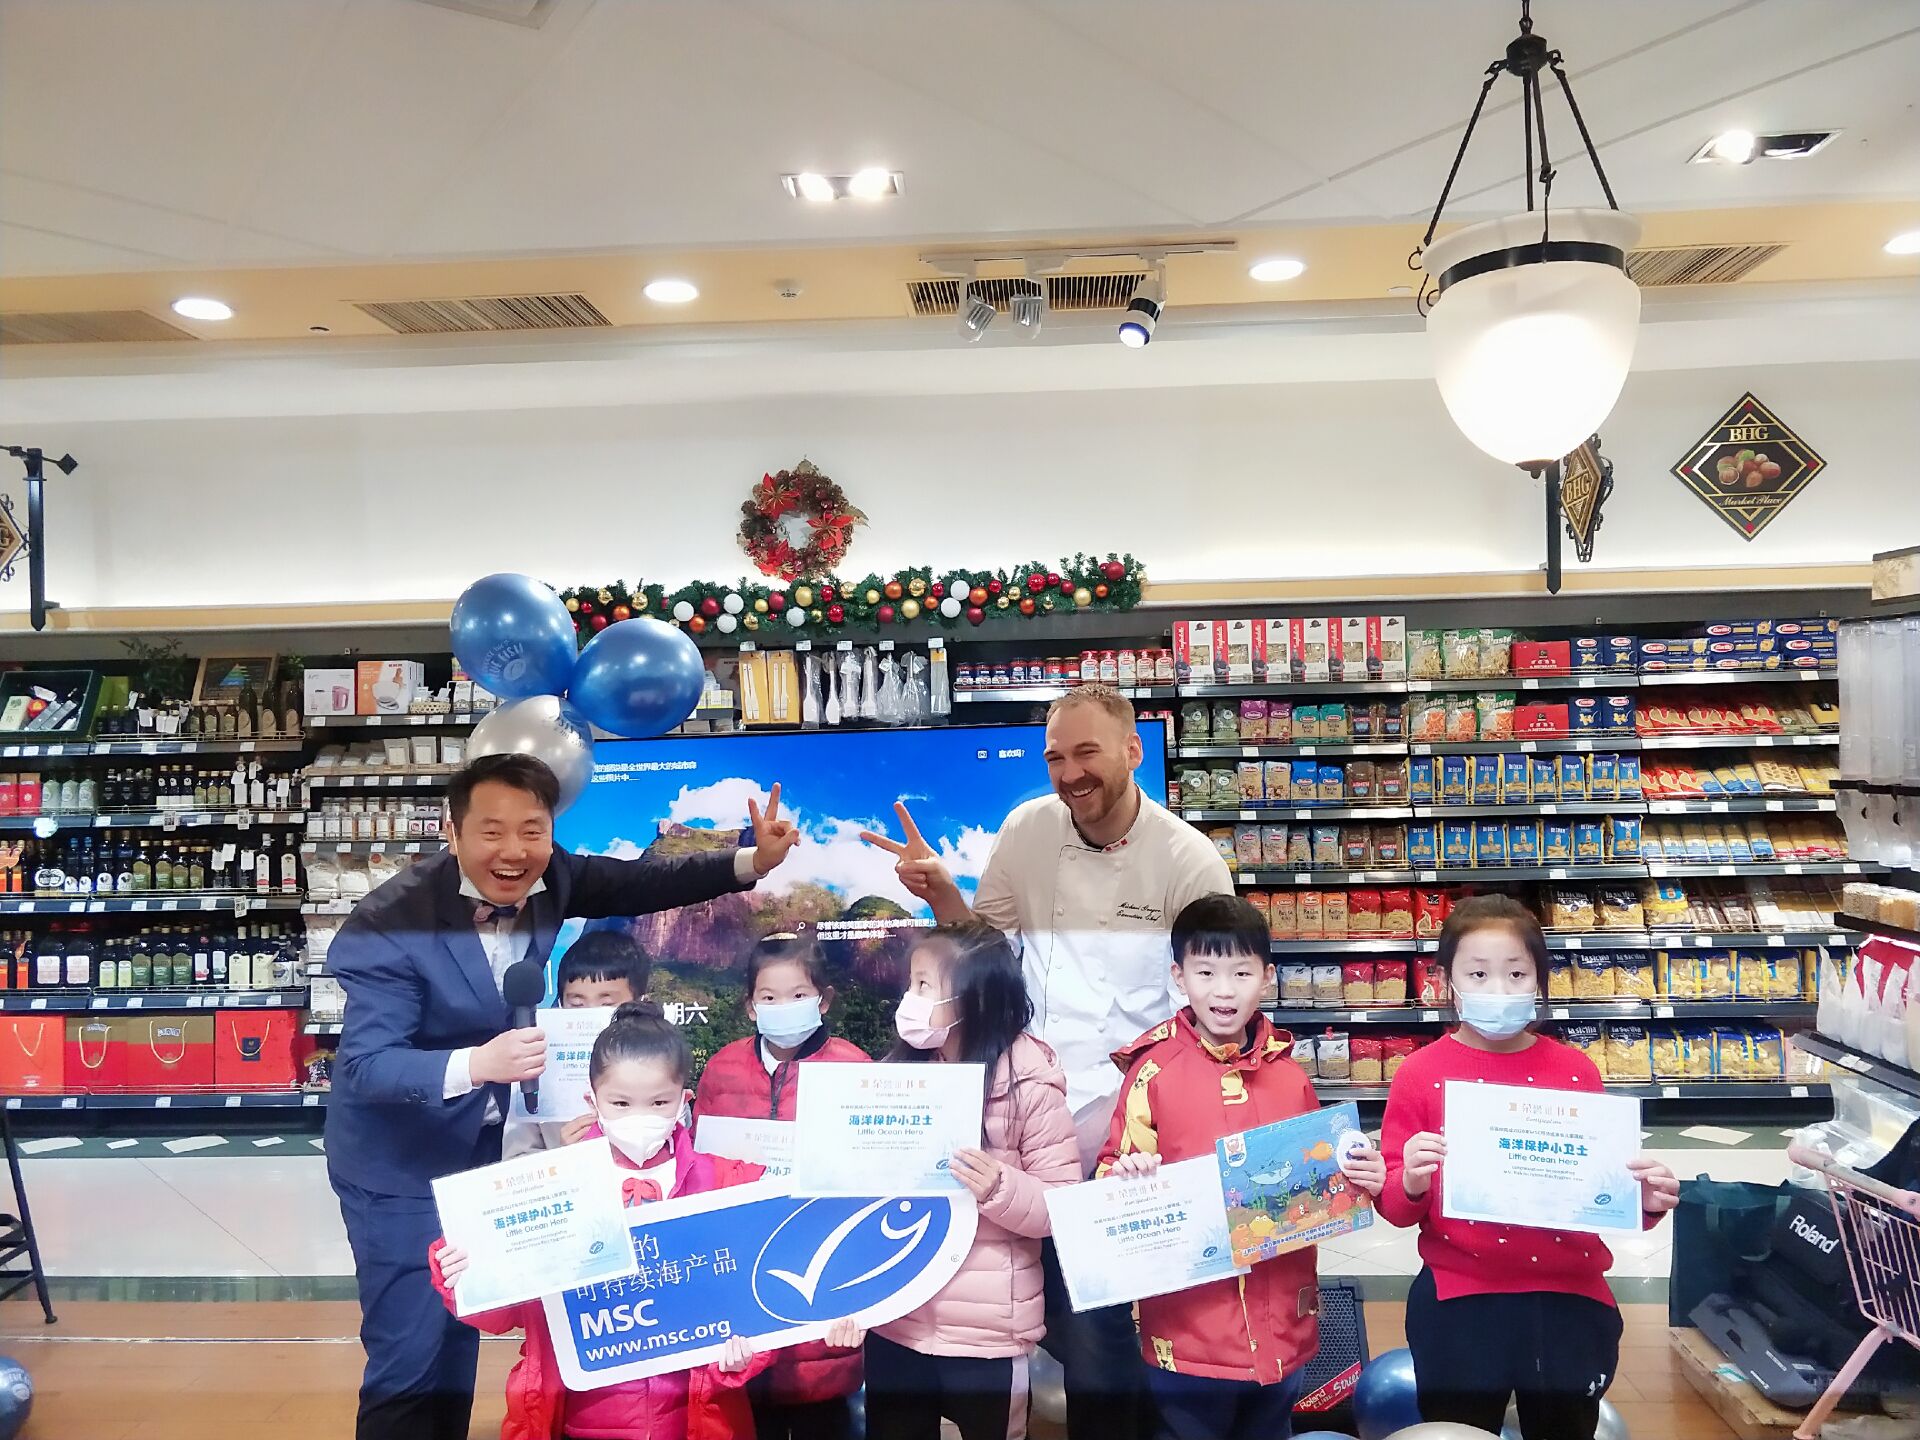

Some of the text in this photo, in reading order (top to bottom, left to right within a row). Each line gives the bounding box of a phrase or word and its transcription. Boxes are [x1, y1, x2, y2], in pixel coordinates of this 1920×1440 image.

[1728, 426, 1769, 443] BHG
[1566, 473, 1590, 502] BHG
[1718, 495, 1756, 507] Market
[848, 1114, 933, 1126] 海洋保护小卫士
[857, 1128, 924, 1136] Little Ocean Hero
[1498, 1137, 1588, 1157] 海洋保护小卫士
[1508, 1152, 1579, 1167] Little Ocean Hero
[494, 1200, 575, 1230] 海洋保护小卫士
[1105, 1210, 1189, 1238] 海洋保护小卫士
[505, 1217, 569, 1238] Little Ocean Hero
[1136, 1230, 1162, 1241] Ocean
[1162, 1226, 1182, 1236] Hero
[1789, 1214, 1840, 1254] Roland
[579, 1298, 660, 1340] MSC
[586, 1319, 732, 1362] www.msc.org
[1299, 1388, 1327, 1411] Roland
